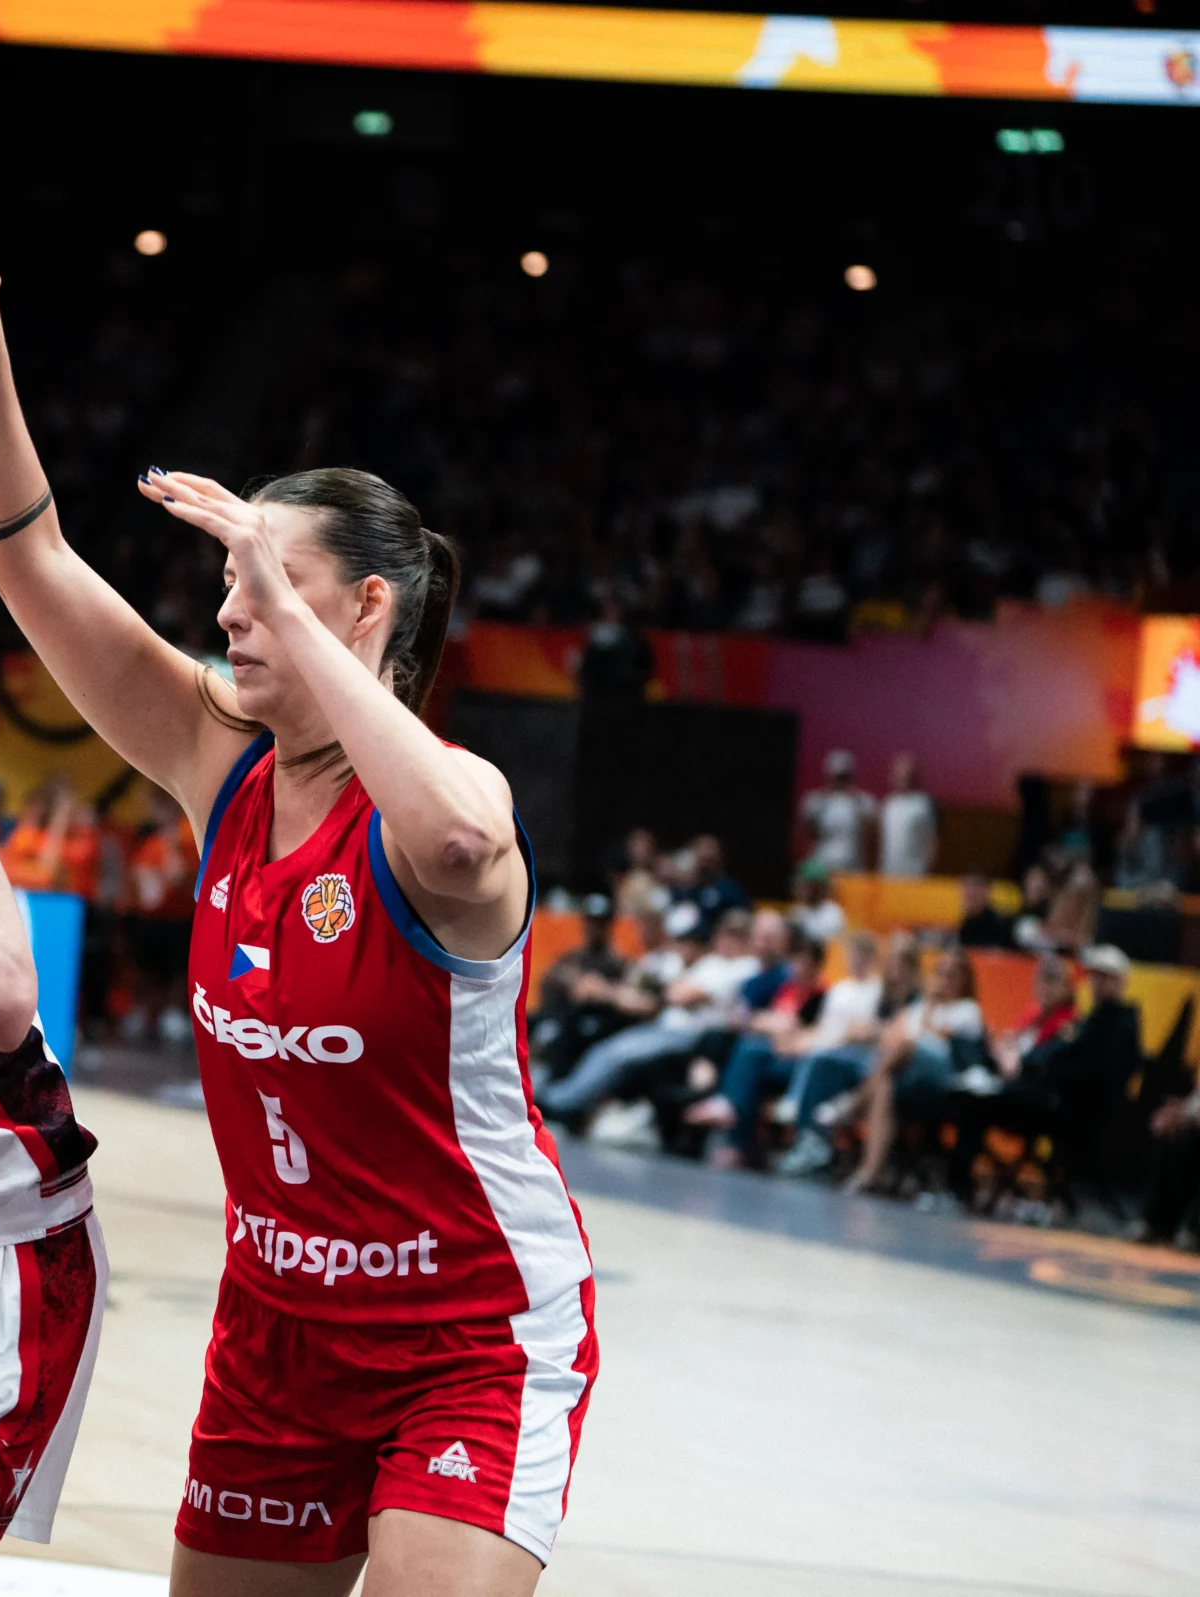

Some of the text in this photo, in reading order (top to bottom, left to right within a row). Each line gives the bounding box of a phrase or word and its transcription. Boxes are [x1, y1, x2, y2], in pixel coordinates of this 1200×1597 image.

[193, 982, 364, 1064] ČESKO
[256, 1086, 310, 1185] 5
[245, 1213, 438, 1286] Tipsport
[427, 1456, 480, 1484] PEAK
